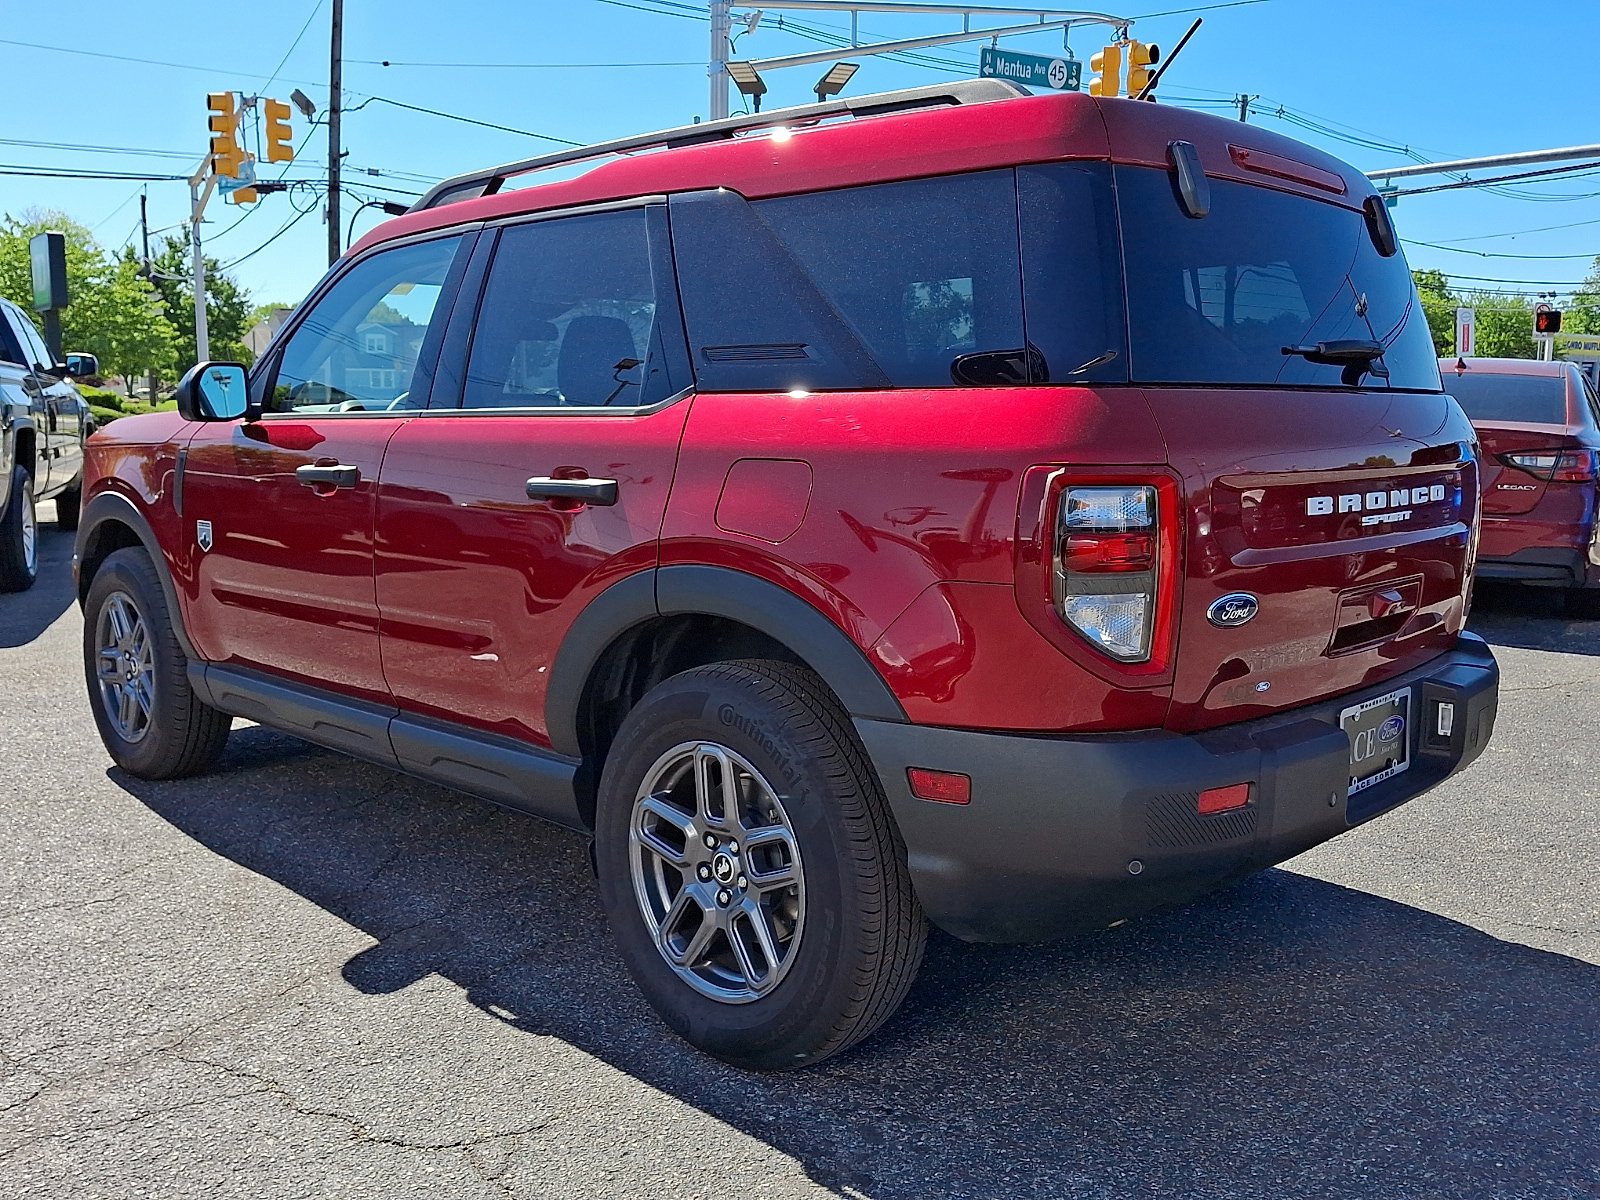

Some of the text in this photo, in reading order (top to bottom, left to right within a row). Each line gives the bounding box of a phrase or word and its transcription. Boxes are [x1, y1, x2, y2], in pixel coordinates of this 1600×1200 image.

[986, 52, 992, 63] N
[996, 57, 1065, 82] Mantua Ave 45
[1071, 65, 1077, 76] S
[1307, 485, 1445, 516] BRONCO
[1361, 510, 1412, 526] SPORT
[1221, 601, 1250, 620] Ford
[718, 703, 803, 788] Continental
[1350, 727, 1377, 765] CE
[1355, 768, 1395, 791] ACE FORD
